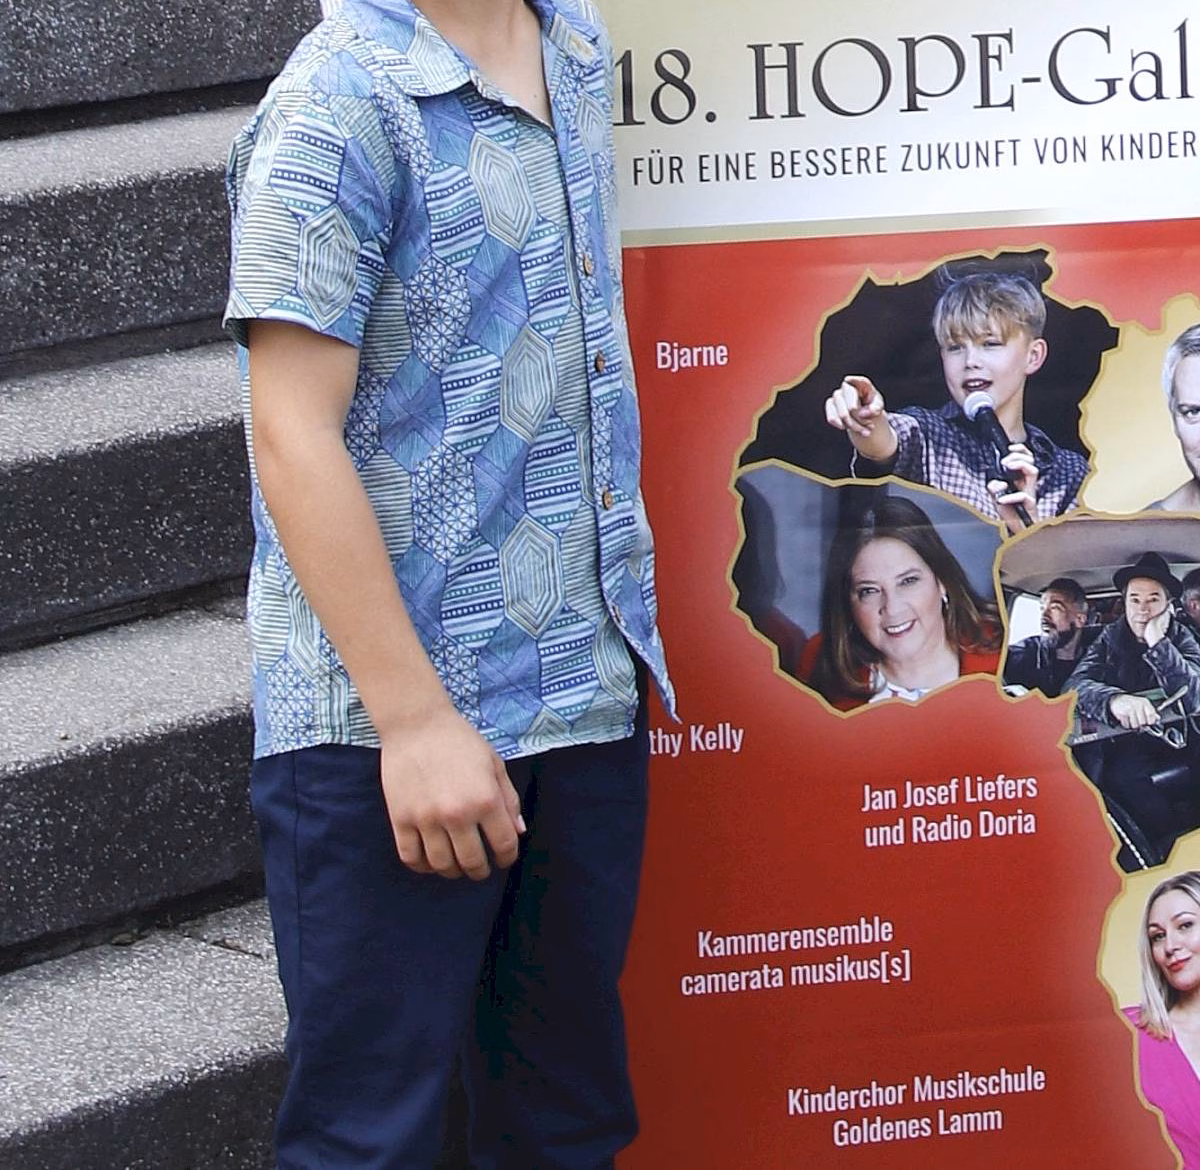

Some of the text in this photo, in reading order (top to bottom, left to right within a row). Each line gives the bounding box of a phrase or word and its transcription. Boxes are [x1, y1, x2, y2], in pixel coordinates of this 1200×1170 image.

[612, 48, 717, 127] 18.
[632, 149, 685, 186] FÜR
[699, 150, 758, 183] EINE
[771, 144, 889, 180] BESSERE
[900, 137, 1023, 173] ZUKUNFT
[1034, 134, 1088, 166] VON
[655, 341, 729, 373] Bjarne
[648, 722, 744, 758] thy Kelly
[861, 773, 1038, 813] Jan Josef Liefers
[864, 808, 1036, 848] und Radio Doria
[697, 915, 894, 958] Kammerensemble
[680, 949, 912, 996] camerata musikus[s]
[787, 1064, 1046, 1116] Kinderchor Musikschule
[832, 1107, 1003, 1147] Goldenes Lamm
